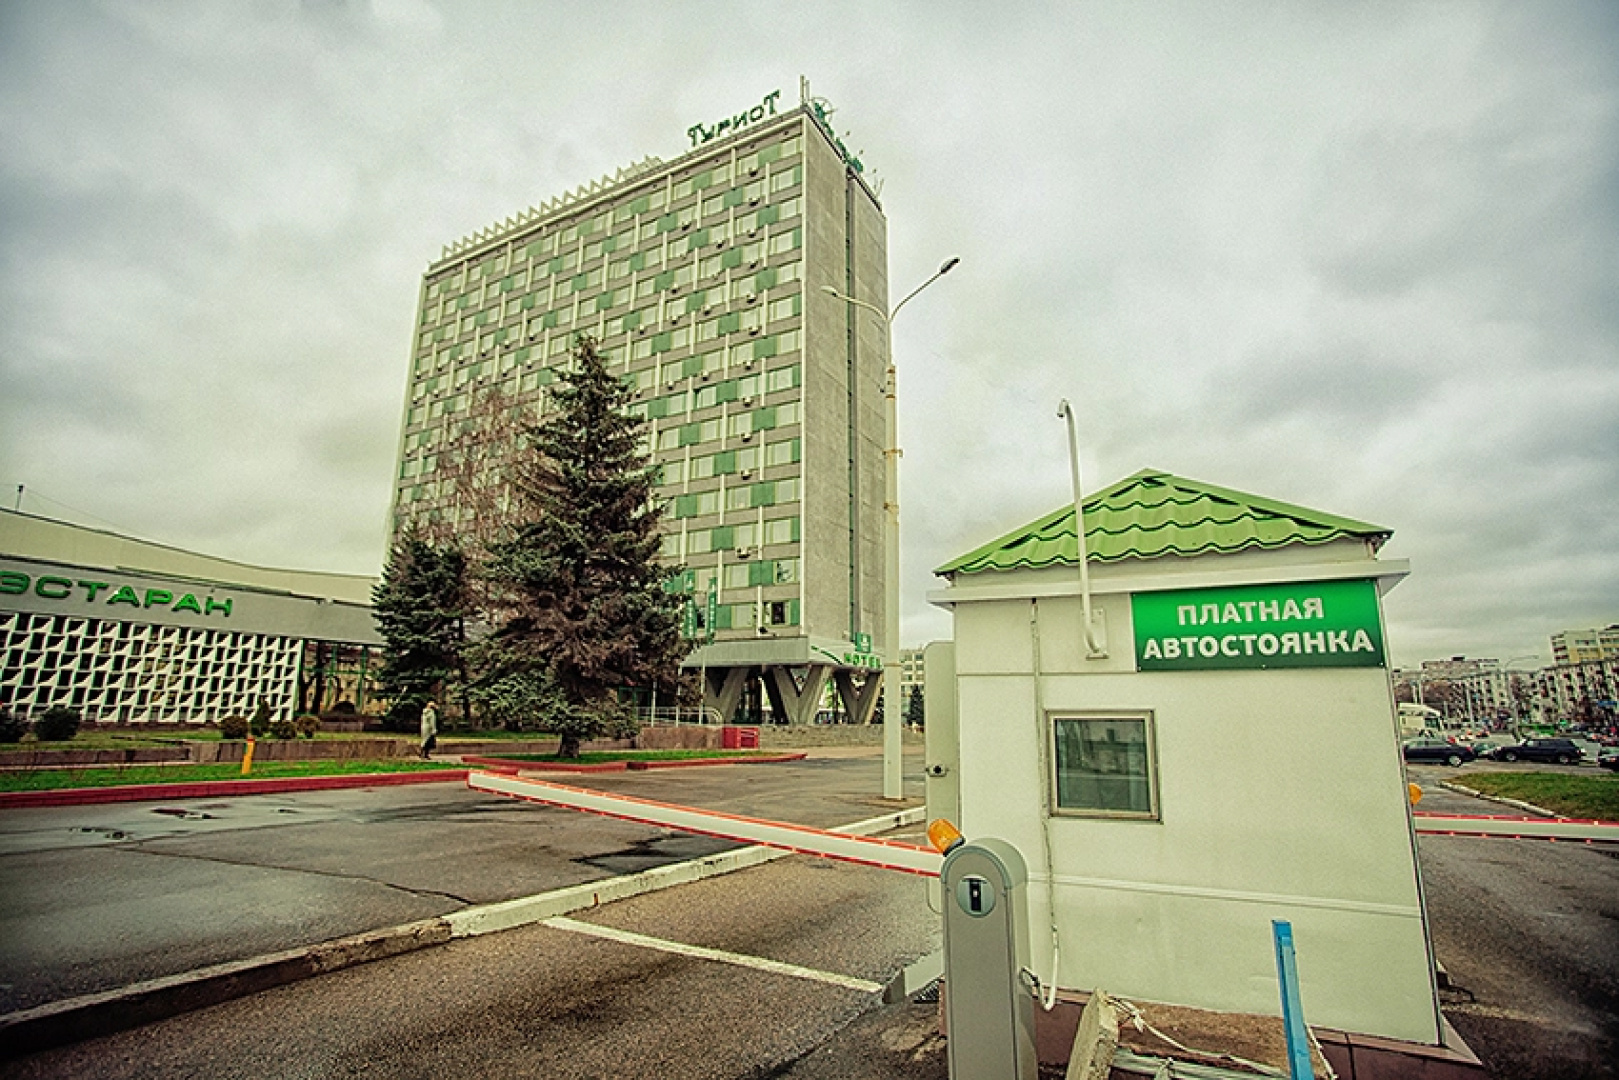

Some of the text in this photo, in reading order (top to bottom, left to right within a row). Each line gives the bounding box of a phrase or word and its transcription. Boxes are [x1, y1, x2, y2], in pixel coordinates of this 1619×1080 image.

[0, 570, 233, 617] ЭСТАРАН
[1177, 597, 1325, 626] ПЛАТНАЯ
[1143, 629, 1375, 660] АВТОСТОЯНКА
